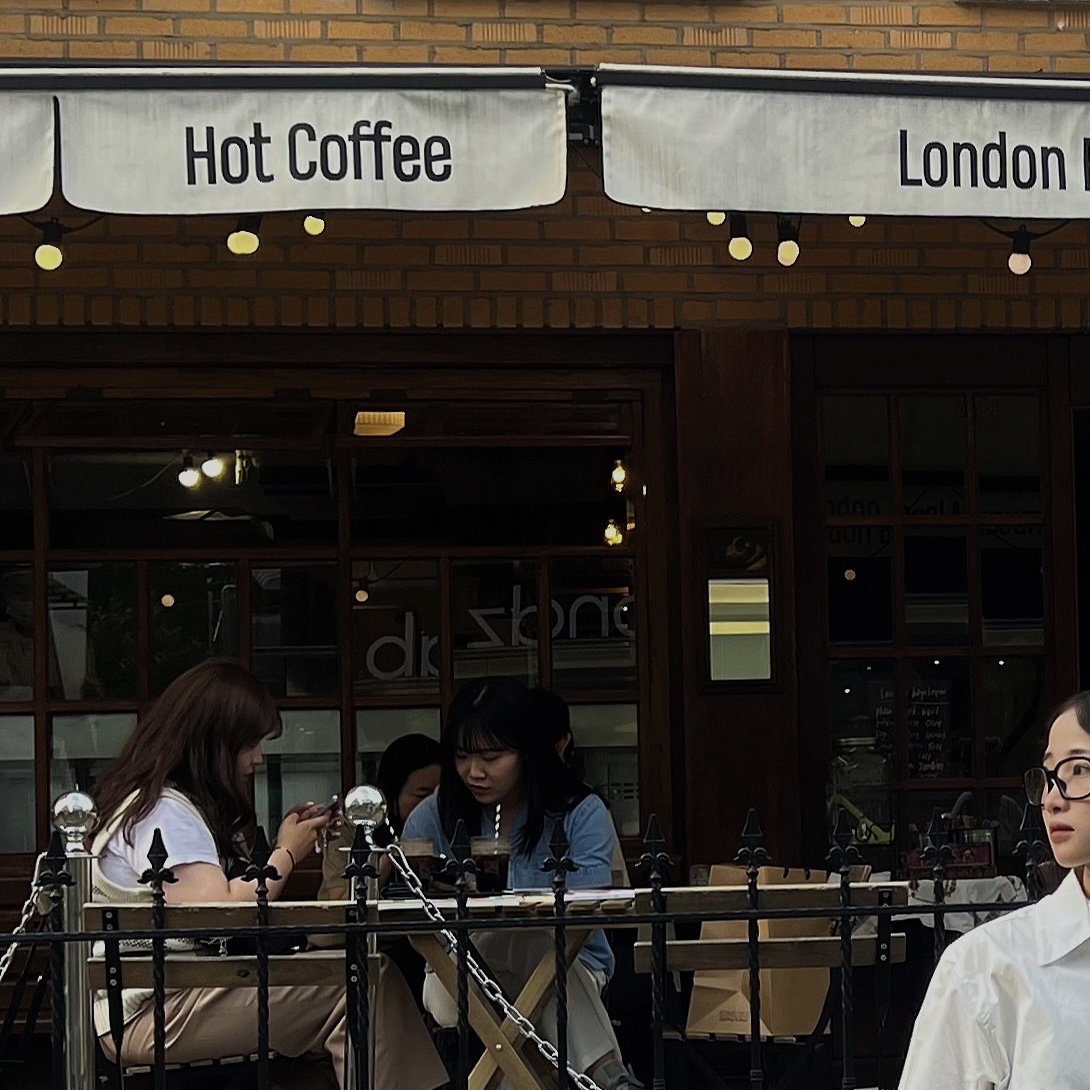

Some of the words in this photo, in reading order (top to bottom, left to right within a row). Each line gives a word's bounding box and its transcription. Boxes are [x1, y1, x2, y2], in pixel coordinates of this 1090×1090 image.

[186, 123, 274, 186] Hot
[288, 119, 452, 183] Coffee
[899, 129, 1067, 191] London
